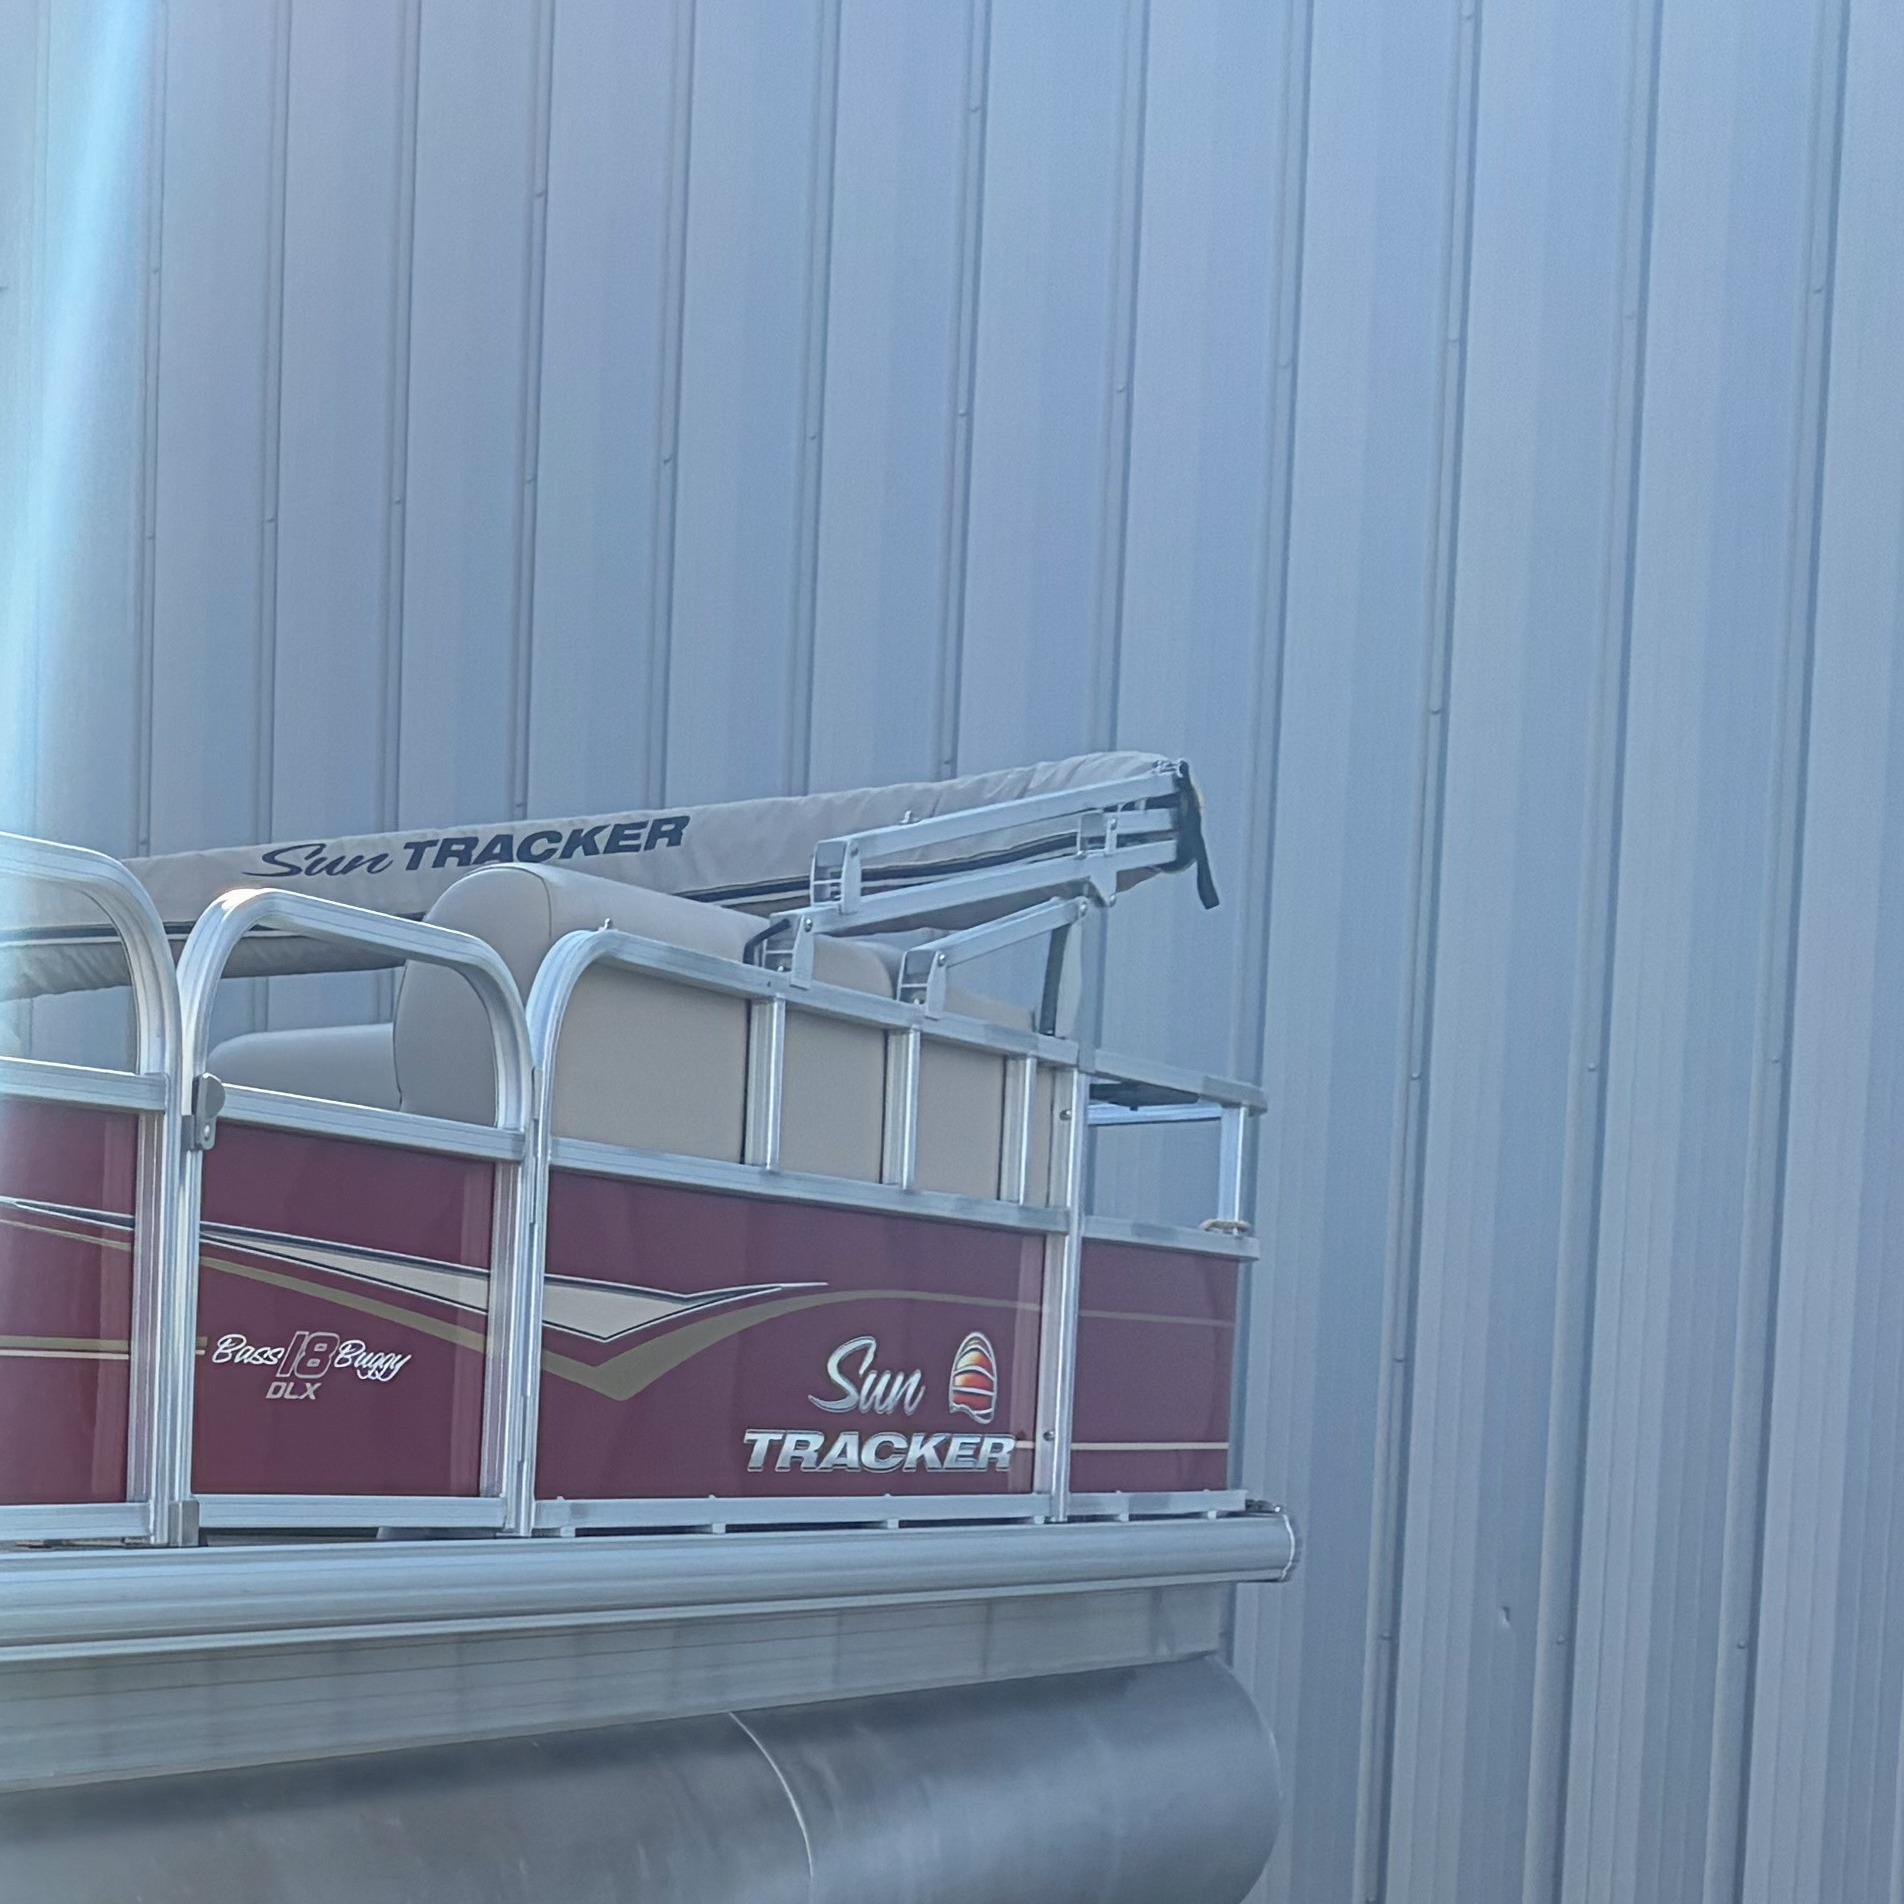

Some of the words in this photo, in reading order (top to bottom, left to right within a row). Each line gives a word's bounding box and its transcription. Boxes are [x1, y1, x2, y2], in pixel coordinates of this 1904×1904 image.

[242, 842, 394, 878] Sun
[403, 814, 691, 872] TRACKER
[211, 1333, 286, 1366] Bass
[276, 1330, 341, 1379] 18
[333, 1339, 412, 1382] Buggy
[807, 1335, 926, 1416] Sun
[265, 1381, 322, 1400] DLX
[743, 1428, 1017, 1473] TRACKER
